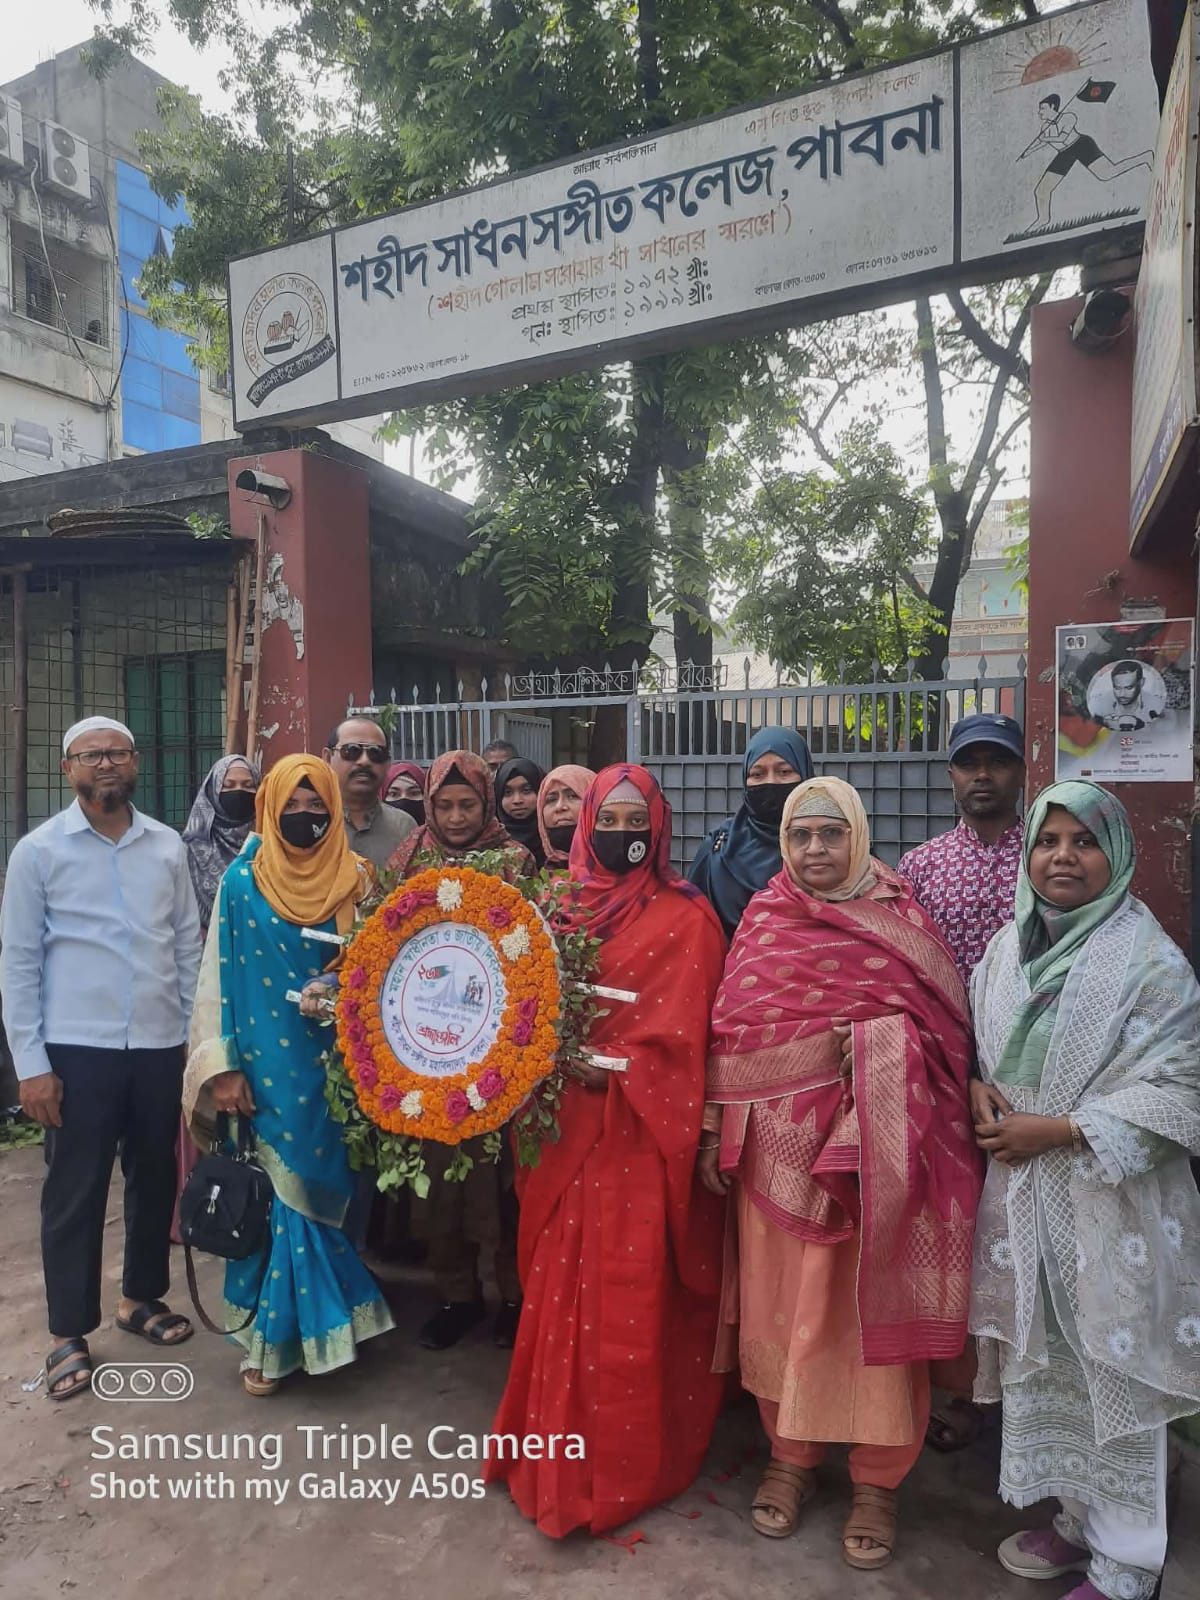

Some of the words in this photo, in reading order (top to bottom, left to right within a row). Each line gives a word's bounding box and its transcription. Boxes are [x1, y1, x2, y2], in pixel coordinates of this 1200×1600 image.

[340, 234, 428, 301] শহীদ
[432, 218, 527, 277] সাধন
[530, 179, 635, 250] সঙ্গীত
[787, 94, 945, 180] পাবনা
[639, 229, 706, 263] সাধনের
[511, 301, 554, 321] প্রথম
[623, 266, 680, 295] ১৯৭২
[624, 288, 685, 319] ১৯৯৯
